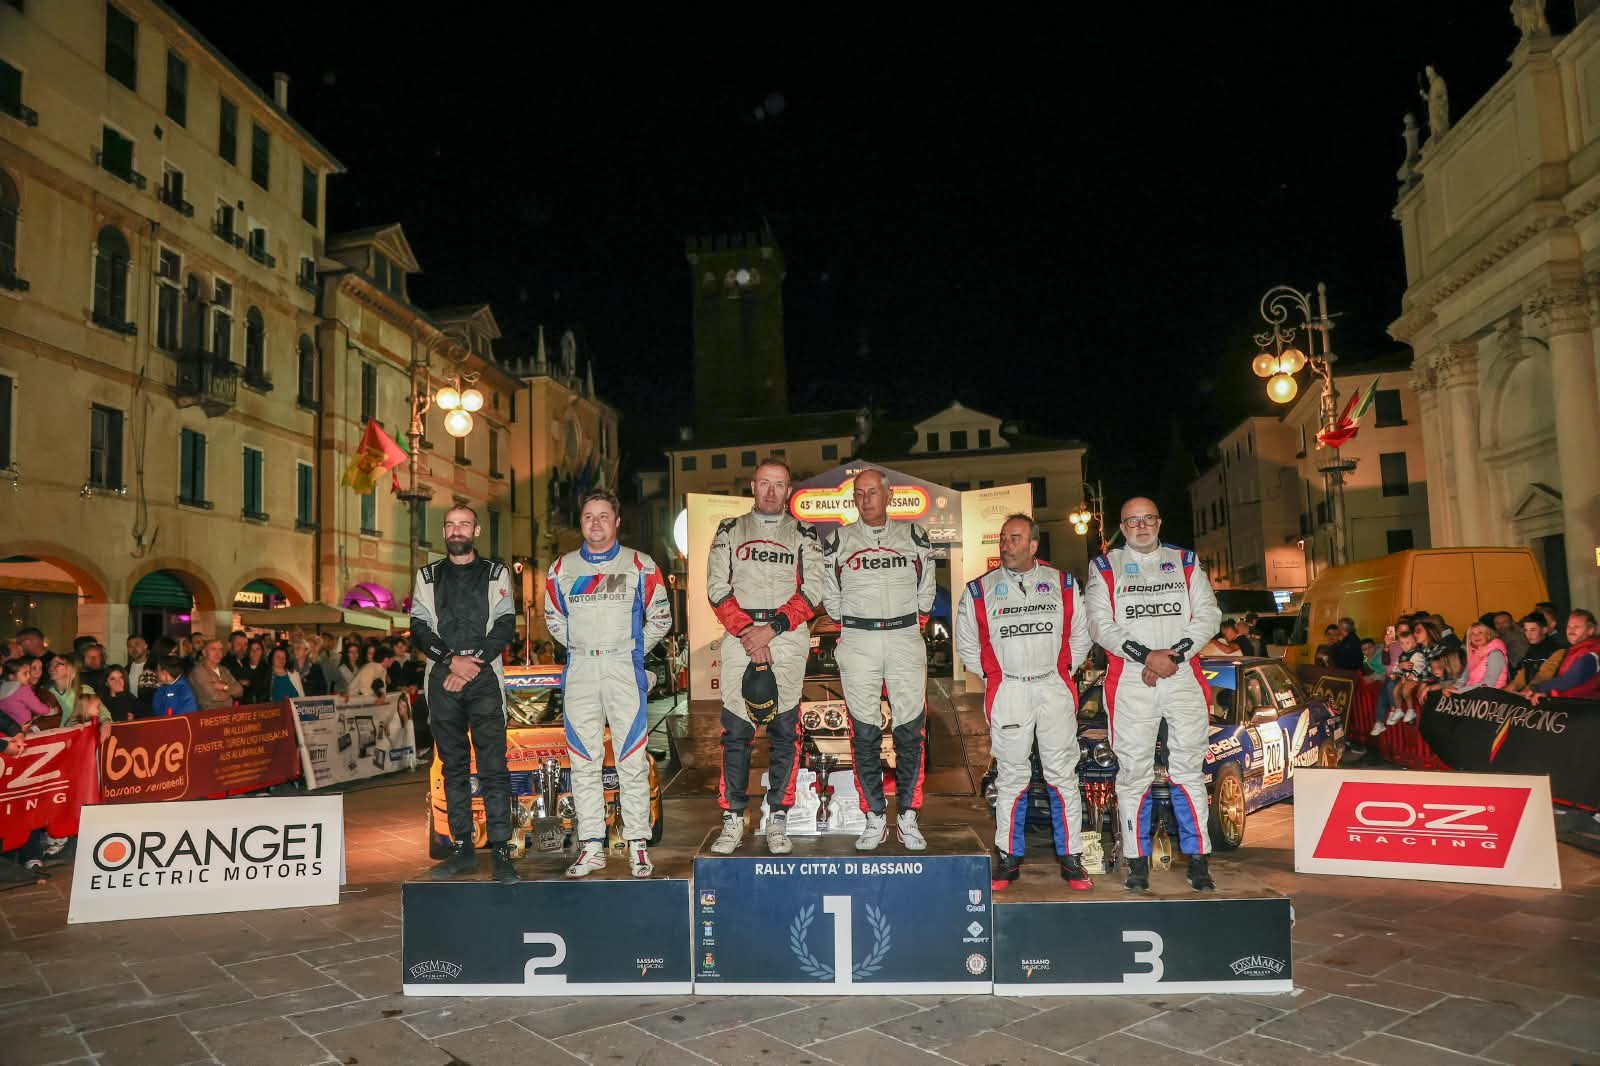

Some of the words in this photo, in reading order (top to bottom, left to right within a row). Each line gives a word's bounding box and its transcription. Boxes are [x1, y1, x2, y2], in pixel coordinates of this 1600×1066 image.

[816, 499, 839, 509] RALLY
[886, 498, 920, 508] ASSANO
[1127, 582, 1174, 593] BORDIN
[568, 594, 625, 604] MOTORSPORT
[1002, 605, 1046, 615] BORDIN
[1125, 602, 1182, 619] sparco
[1000, 622, 1054, 638] sparco
[1266, 744, 1281, 773] 202
[92, 823, 323, 872] ORANGE1
[1349, 834, 1497, 849] RACING
[90, 868, 210, 890] ELECTRIC
[224, 861, 323, 881] MOTORS
[755, 864, 796, 875] RALLY
[800, 863, 841, 874] CITTA'
[845, 863, 858, 874] DI
[862, 862, 923, 874] BASSANO
[823, 896, 852, 983] 1
[523, 932, 567, 984] 2
[1122, 930, 1164, 982] 3
